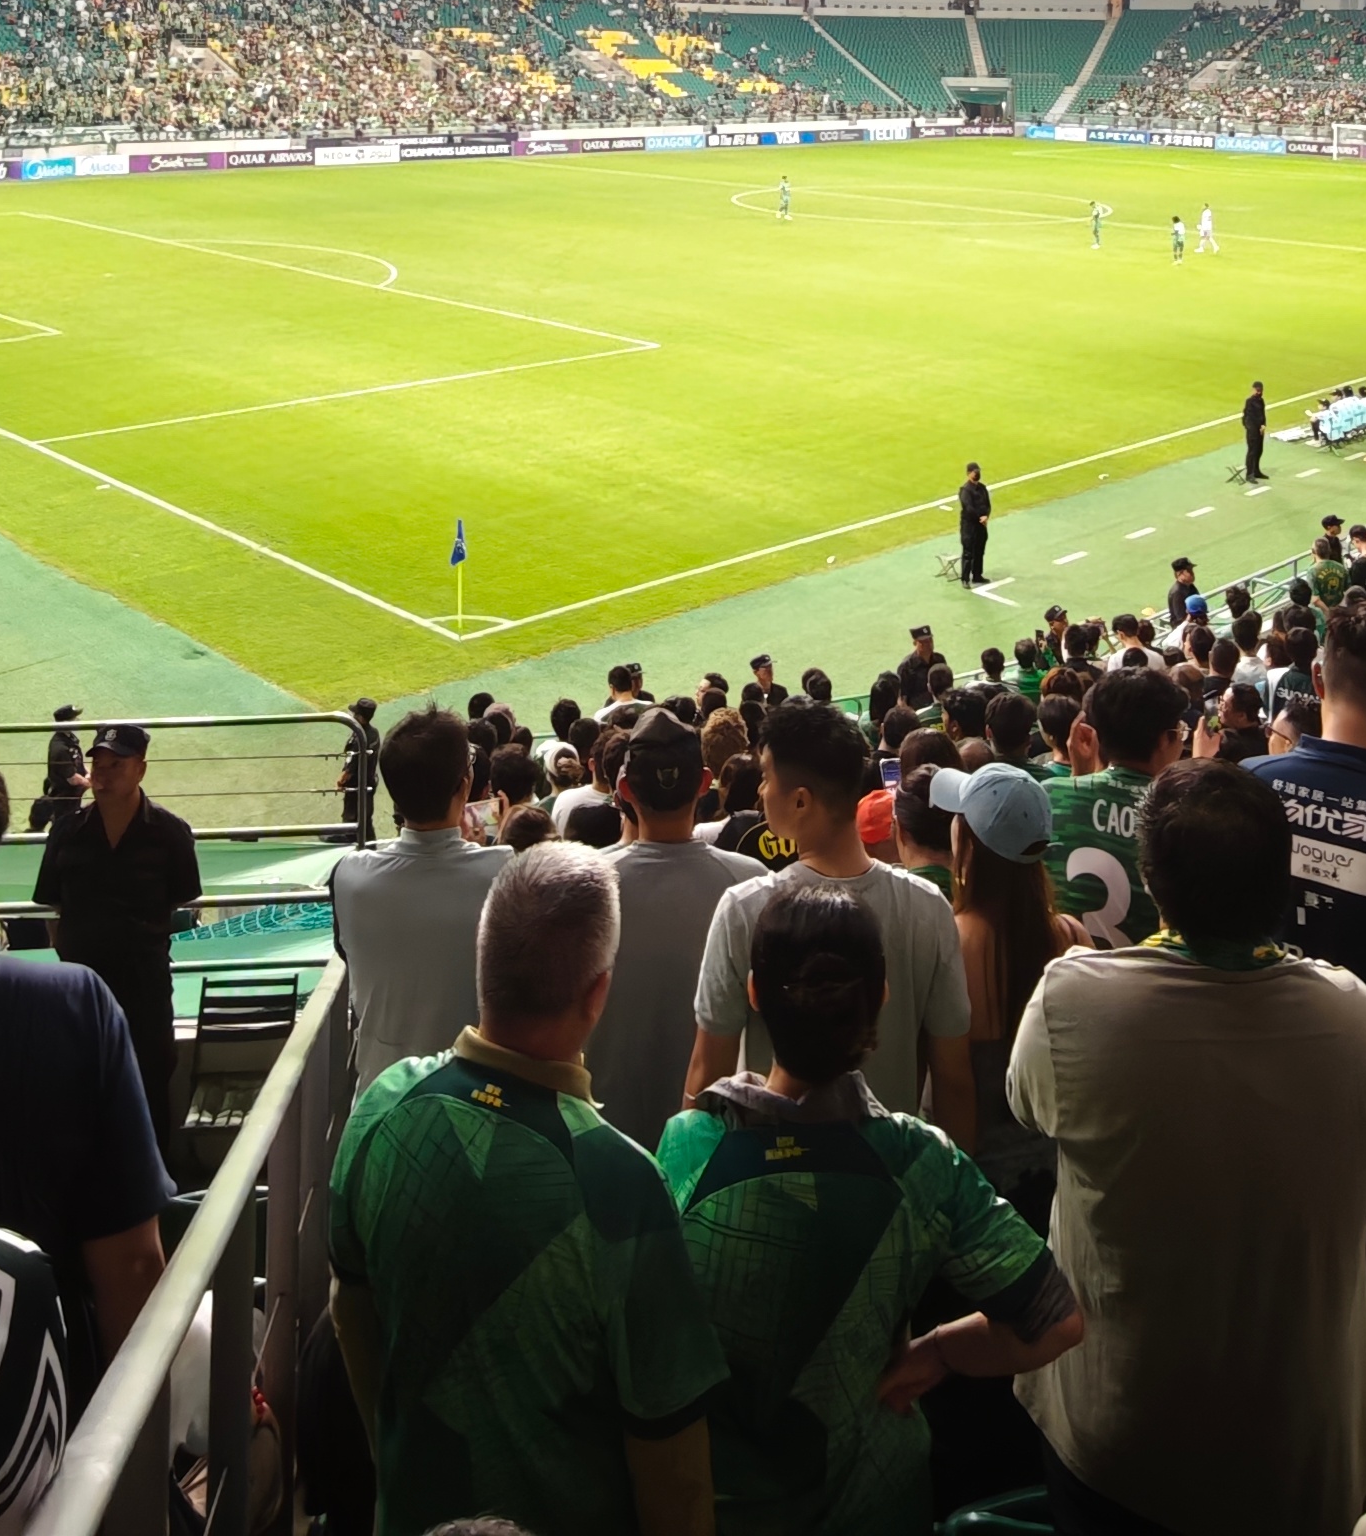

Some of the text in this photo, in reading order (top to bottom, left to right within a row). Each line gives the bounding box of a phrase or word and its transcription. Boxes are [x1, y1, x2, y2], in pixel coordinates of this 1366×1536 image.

[647, 135, 692, 149] OXAGON
[775, 131, 800, 145] VISA
[1088, 130, 1146, 144] ASPETAR
[1217, 137, 1269, 151] OXAGON
[455, 145, 486, 156] LEAGUE
[487, 144, 511, 154] ELITE
[583, 140, 610, 151] QATAR
[1288, 143, 1318, 153] QATAR
[229, 151, 313, 165] QATAR AIRWAYS
[324, 152, 352, 160] NEOM
[1092, 798, 1136, 838] CAO
